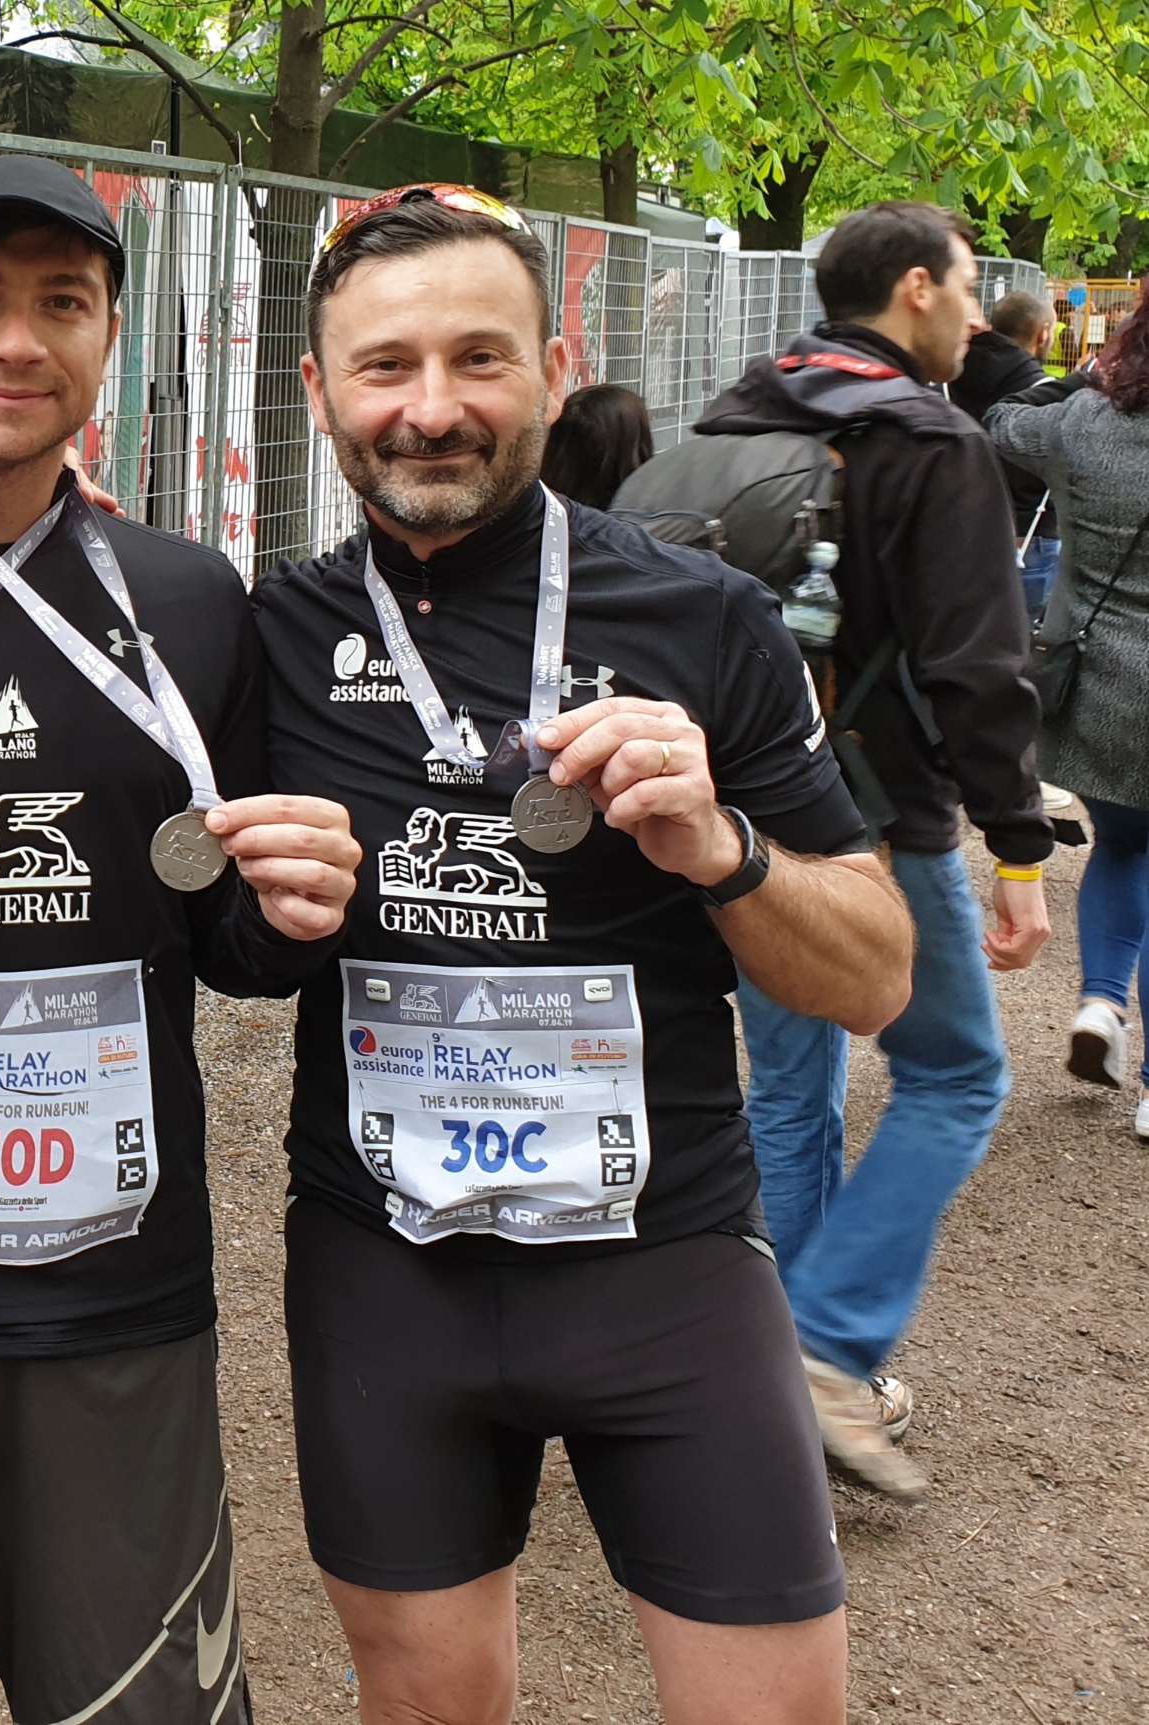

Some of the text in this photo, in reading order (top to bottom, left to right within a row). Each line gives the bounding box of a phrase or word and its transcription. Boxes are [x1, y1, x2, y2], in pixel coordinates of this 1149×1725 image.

[377, 598, 410, 670] RELAY MARATHON
[383, 594, 399, 620] EUROP
[393, 621, 421, 672] ASSISTANCE
[428, 775, 484, 785] MARATHON
[379, 901, 549, 942] GENERALI
[44, 991, 97, 1009] MILANO
[501, 993, 571, 1008] MILANO
[44, 1007, 98, 1021] MARATHON
[400, 1010, 442, 1023] GENERALI
[502, 1008, 572, 1019] MARATHON
[539, 1018, 573, 1027] 07.04.19
[380, 1044, 512, 1066] europ RELAY
[353, 1057, 557, 1083] assistance MARATHON
[25, 1100, 90, 1118] RUN&FUN!
[419, 1094, 564, 1110] THE 4 FOR RUN&FUN!
[441, 1119, 548, 1173] 30C
[424, 1203, 490, 1224] NDER
[496, 1206, 603, 1226] ARMOUR
[25, 1217, 119, 1248] ARMOUR
